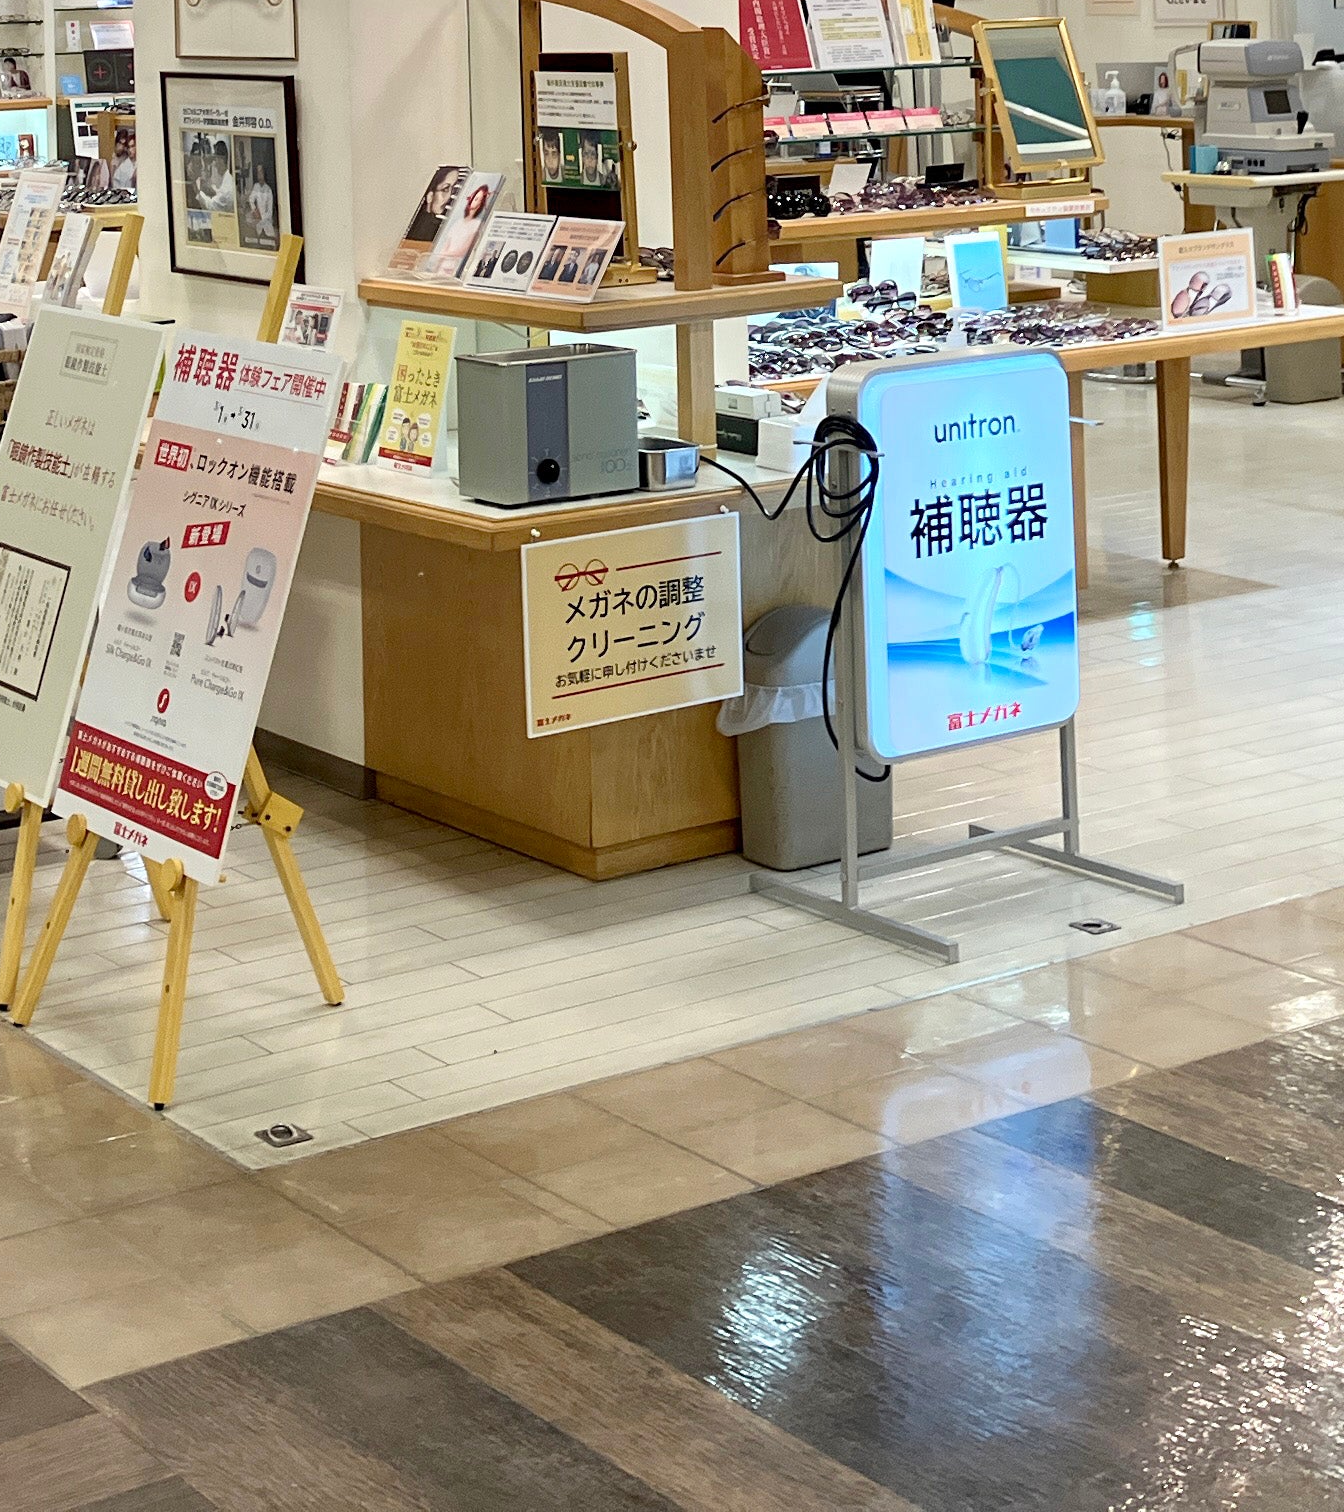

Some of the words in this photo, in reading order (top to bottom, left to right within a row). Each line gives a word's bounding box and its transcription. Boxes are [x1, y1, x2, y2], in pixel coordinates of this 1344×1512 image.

[172, 342, 240, 392] 補聴器
[237, 364, 328, 401] 体験フェア開催中
[393, 384, 438, 408] 富士メガネ
[934, 413, 1017, 443] unitron
[929, 471, 993, 489] Hearing
[1004, 466, 1029, 479] aid
[188, 523, 225, 545] 新登場
[910, 482, 1049, 559] 補聴器
[565, 574, 705, 624] メガネの調整
[567, 611, 706, 663] クリーニング
[555, 645, 717, 689] お気軽に申し付けくださいませ
[536, 713, 572, 727] 富士メガネ
[946, 701, 1022, 731] 富士メガネ
[113, 821, 149, 847] 富士メガネ
